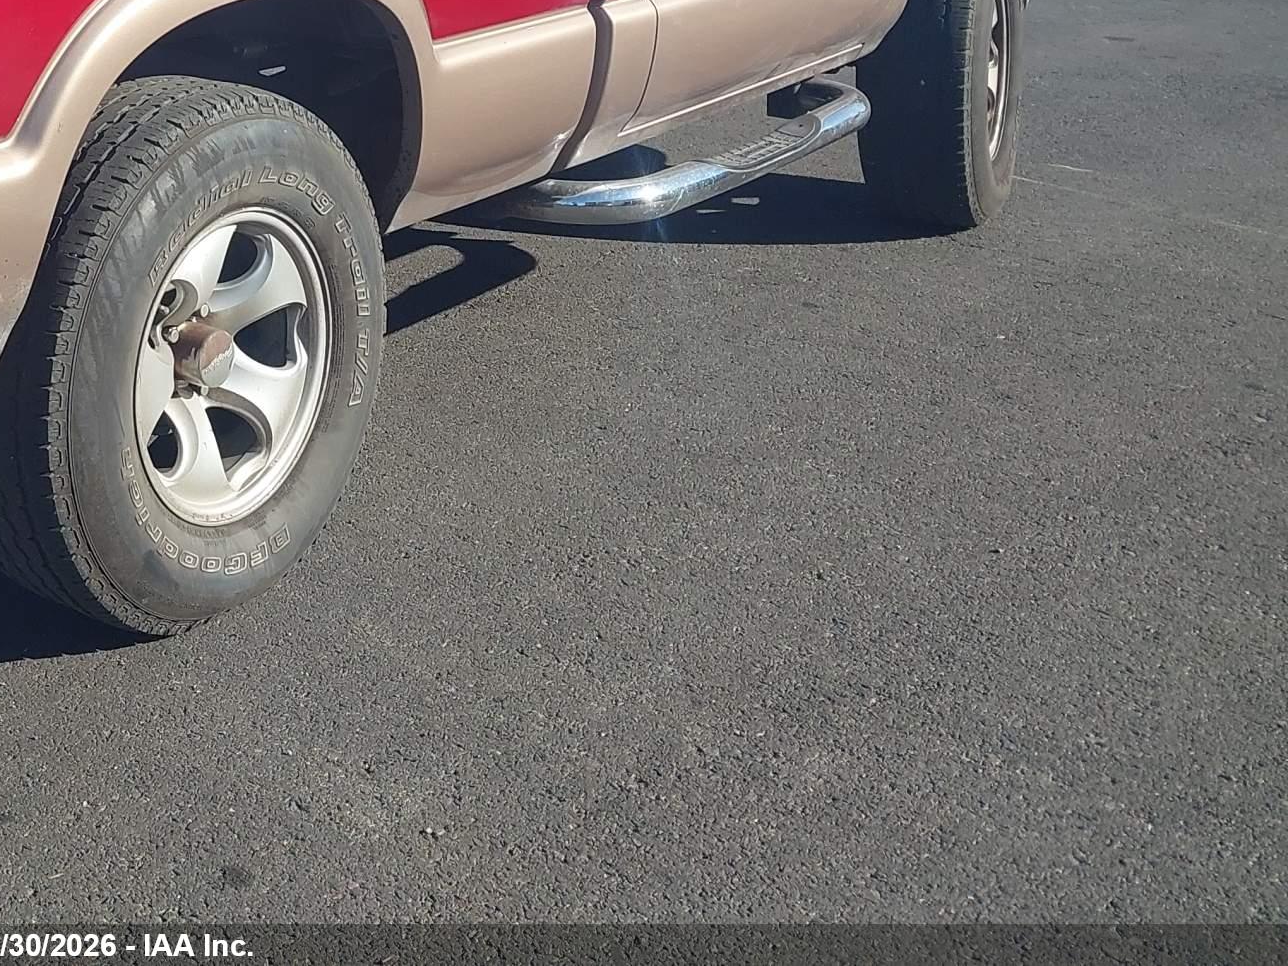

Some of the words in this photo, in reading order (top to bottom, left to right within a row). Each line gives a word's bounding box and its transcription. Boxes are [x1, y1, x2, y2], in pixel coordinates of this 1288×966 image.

[148, 170, 253, 287] Radial
[259, 165, 336, 216] Long
[334, 211, 371, 316] Trail
[348, 328, 370, 407] T/A
[119, 446, 292, 576] BFGoodrich
